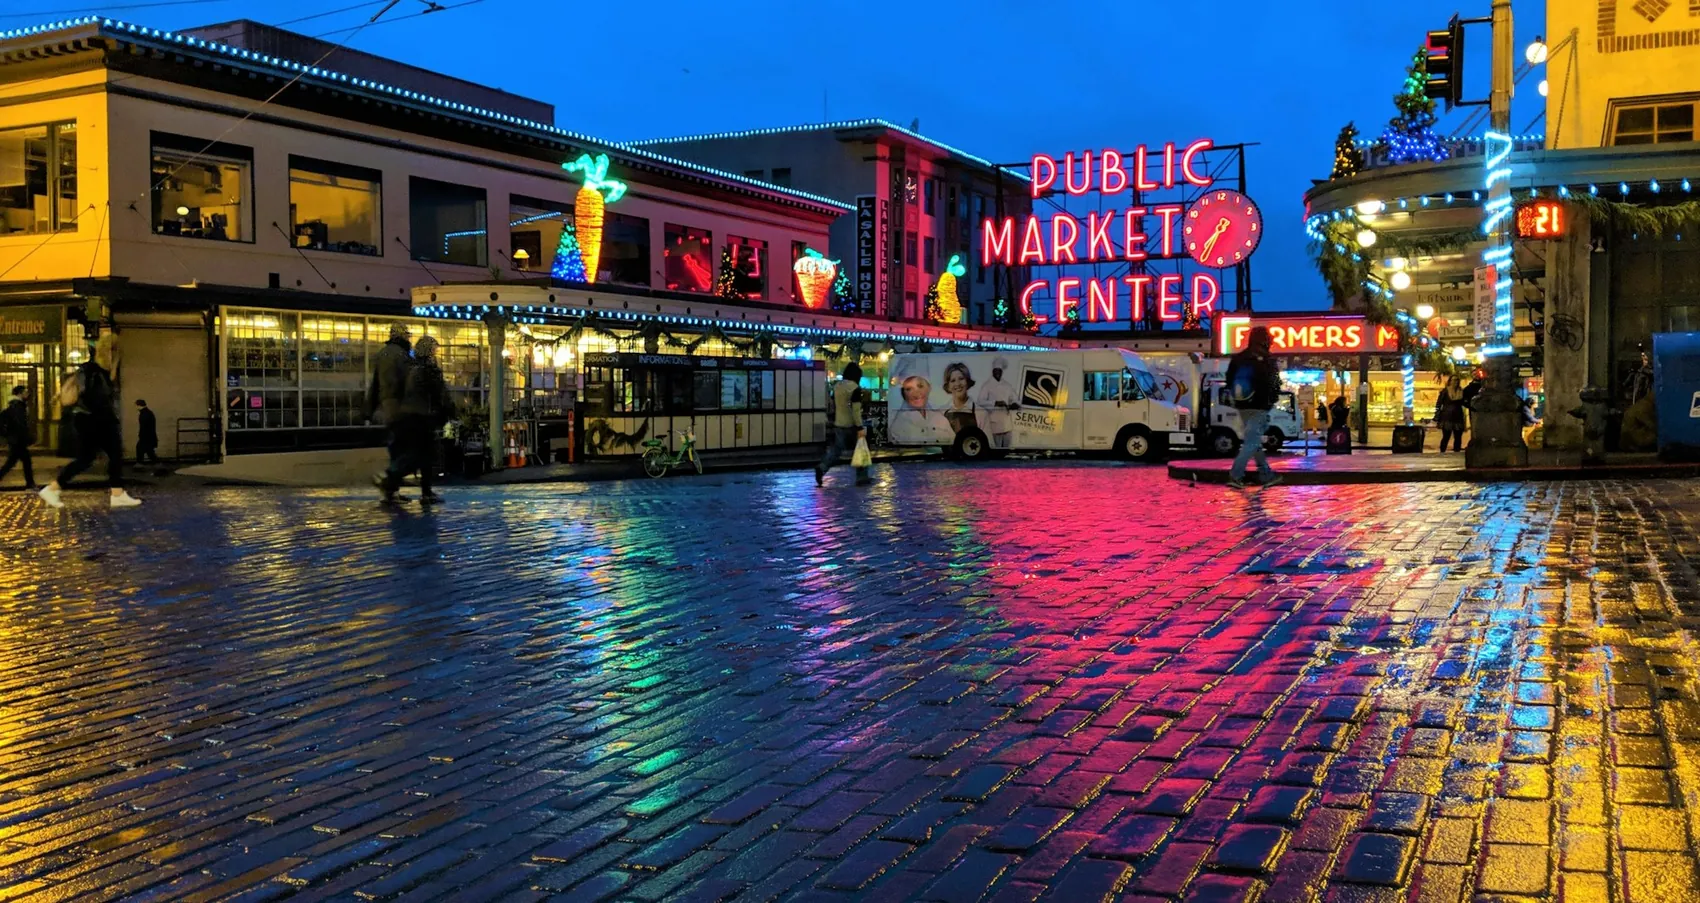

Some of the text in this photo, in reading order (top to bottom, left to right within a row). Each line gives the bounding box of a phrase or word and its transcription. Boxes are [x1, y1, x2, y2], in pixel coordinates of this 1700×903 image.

[1031, 138, 1213, 199] PUBLIC
[1218, 192, 1226, 200] 12
[860, 200, 872, 217] LA
[881, 201, 888, 219] LA
[1247, 207, 1252, 215] 2
[1251, 223, 1256, 231] 3
[1536, 206, 1559, 233] 21
[982, 204, 1183, 266] MARKET
[1186, 226, 1192, 234] 9
[860, 221, 873, 266] SALLE
[1217, 256, 1224, 264] 6
[1020, 273, 1219, 324] CENTER
[1235, 325, 1361, 348] FRMERS
[1015, 412, 1057, 426] SERVICE
